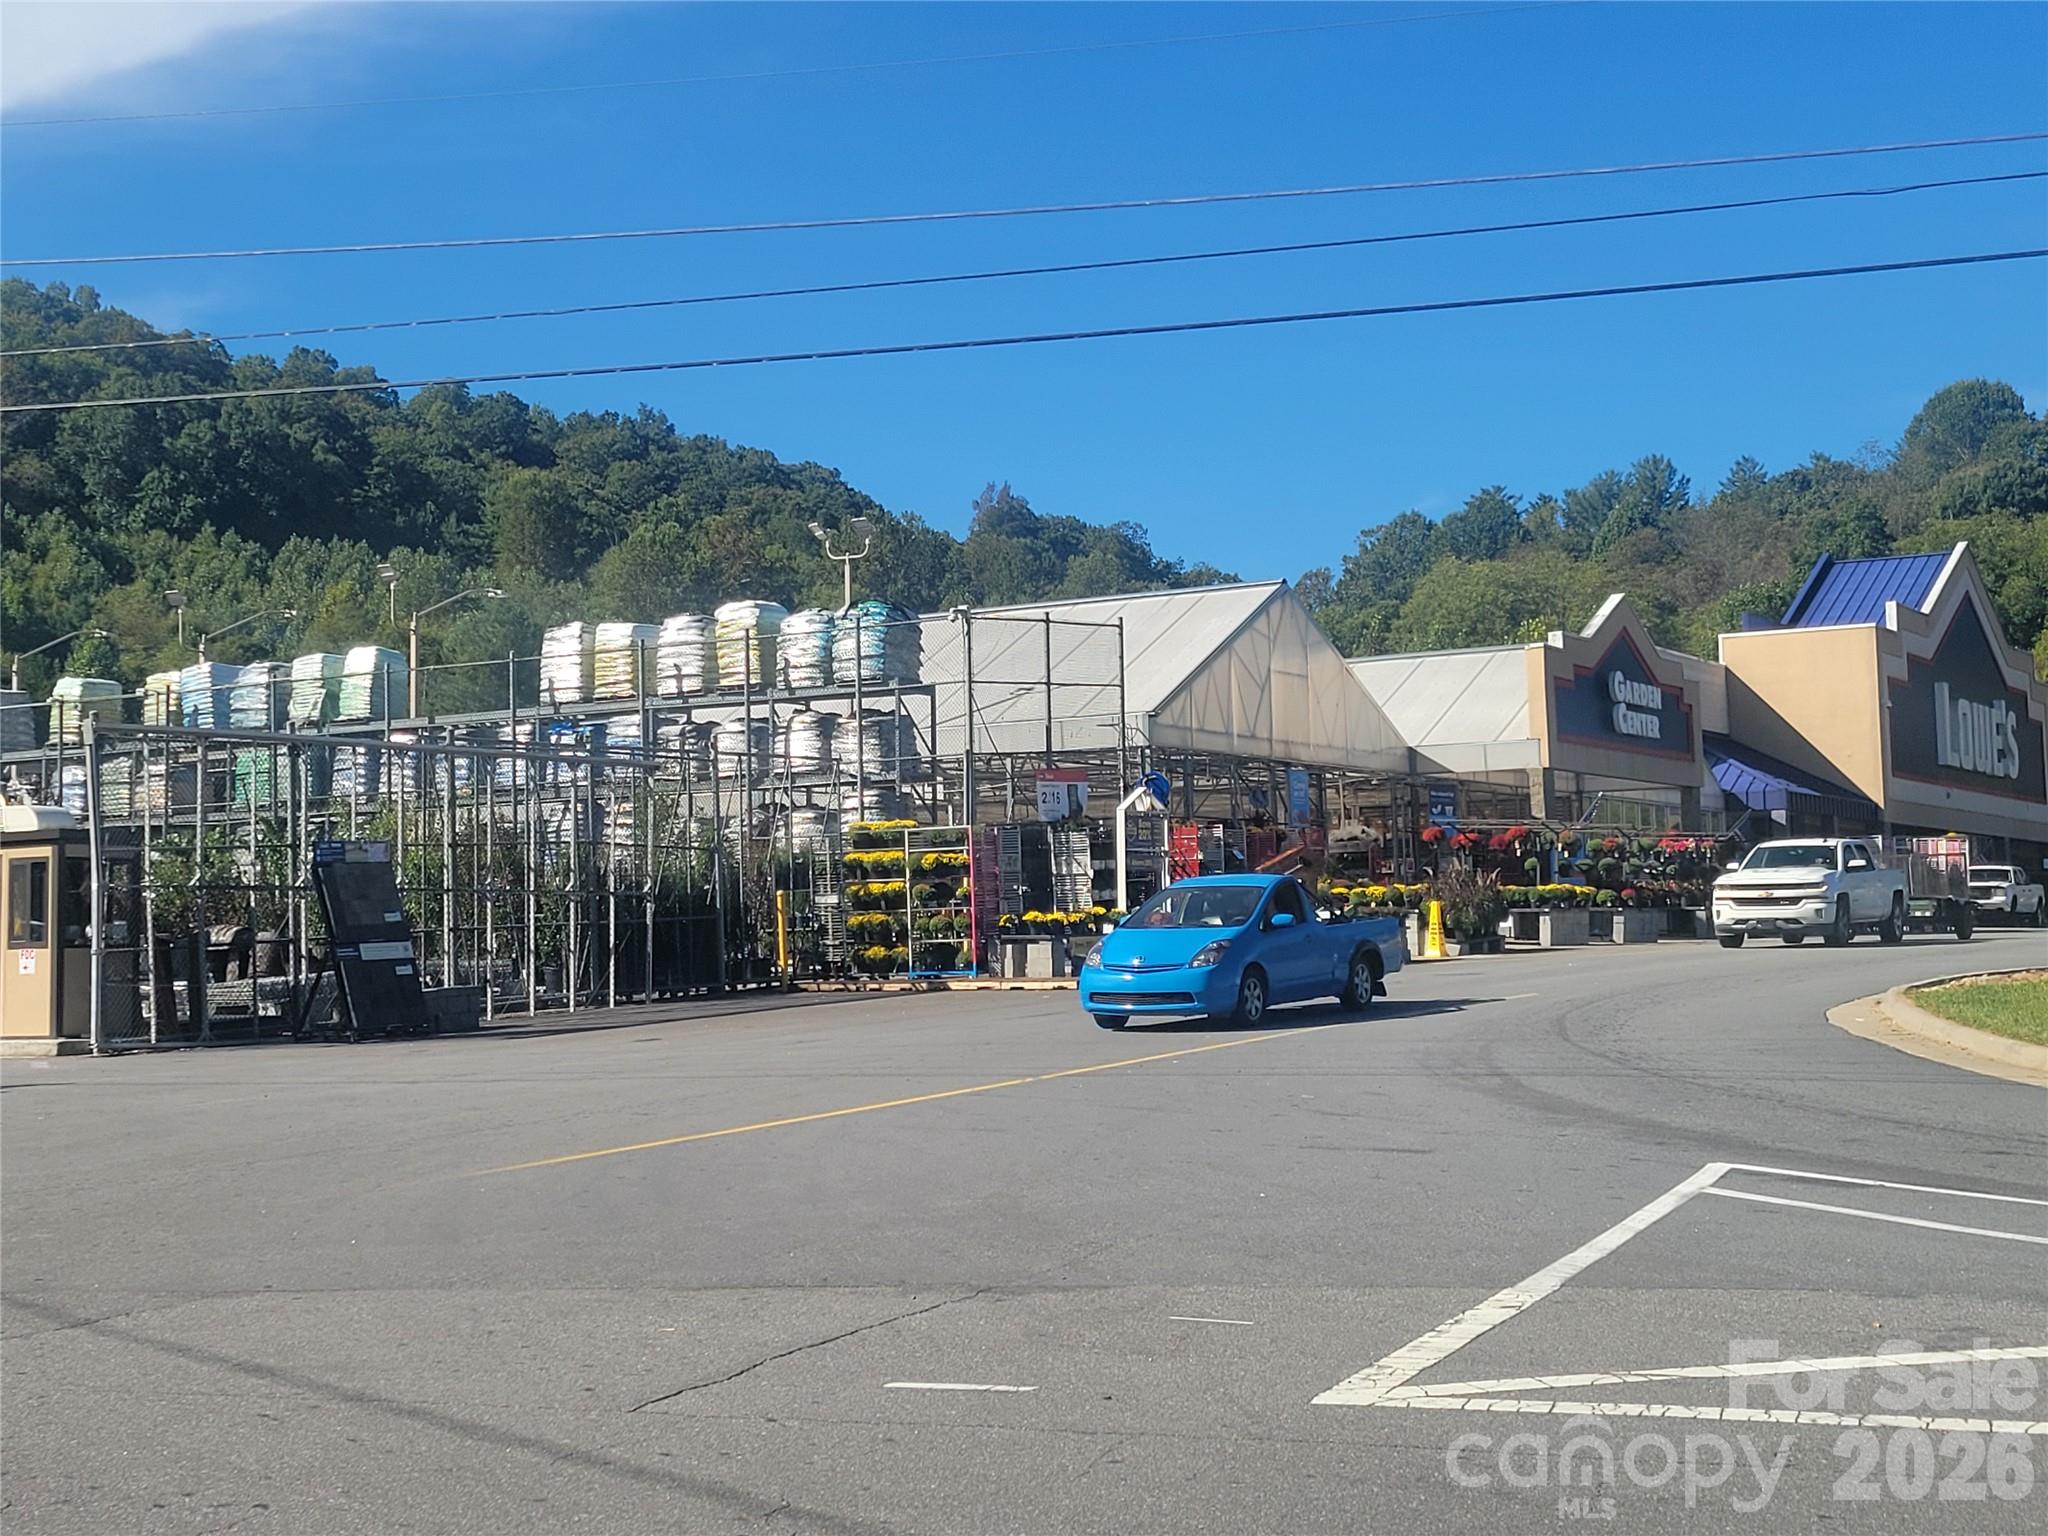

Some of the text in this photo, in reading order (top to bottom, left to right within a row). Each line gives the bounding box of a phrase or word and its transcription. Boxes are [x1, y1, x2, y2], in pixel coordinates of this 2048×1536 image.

[1610, 670, 1662, 710] GARDEN
[1613, 702, 1661, 738] CENTER
[1934, 682, 2019, 779] LOWE'S
